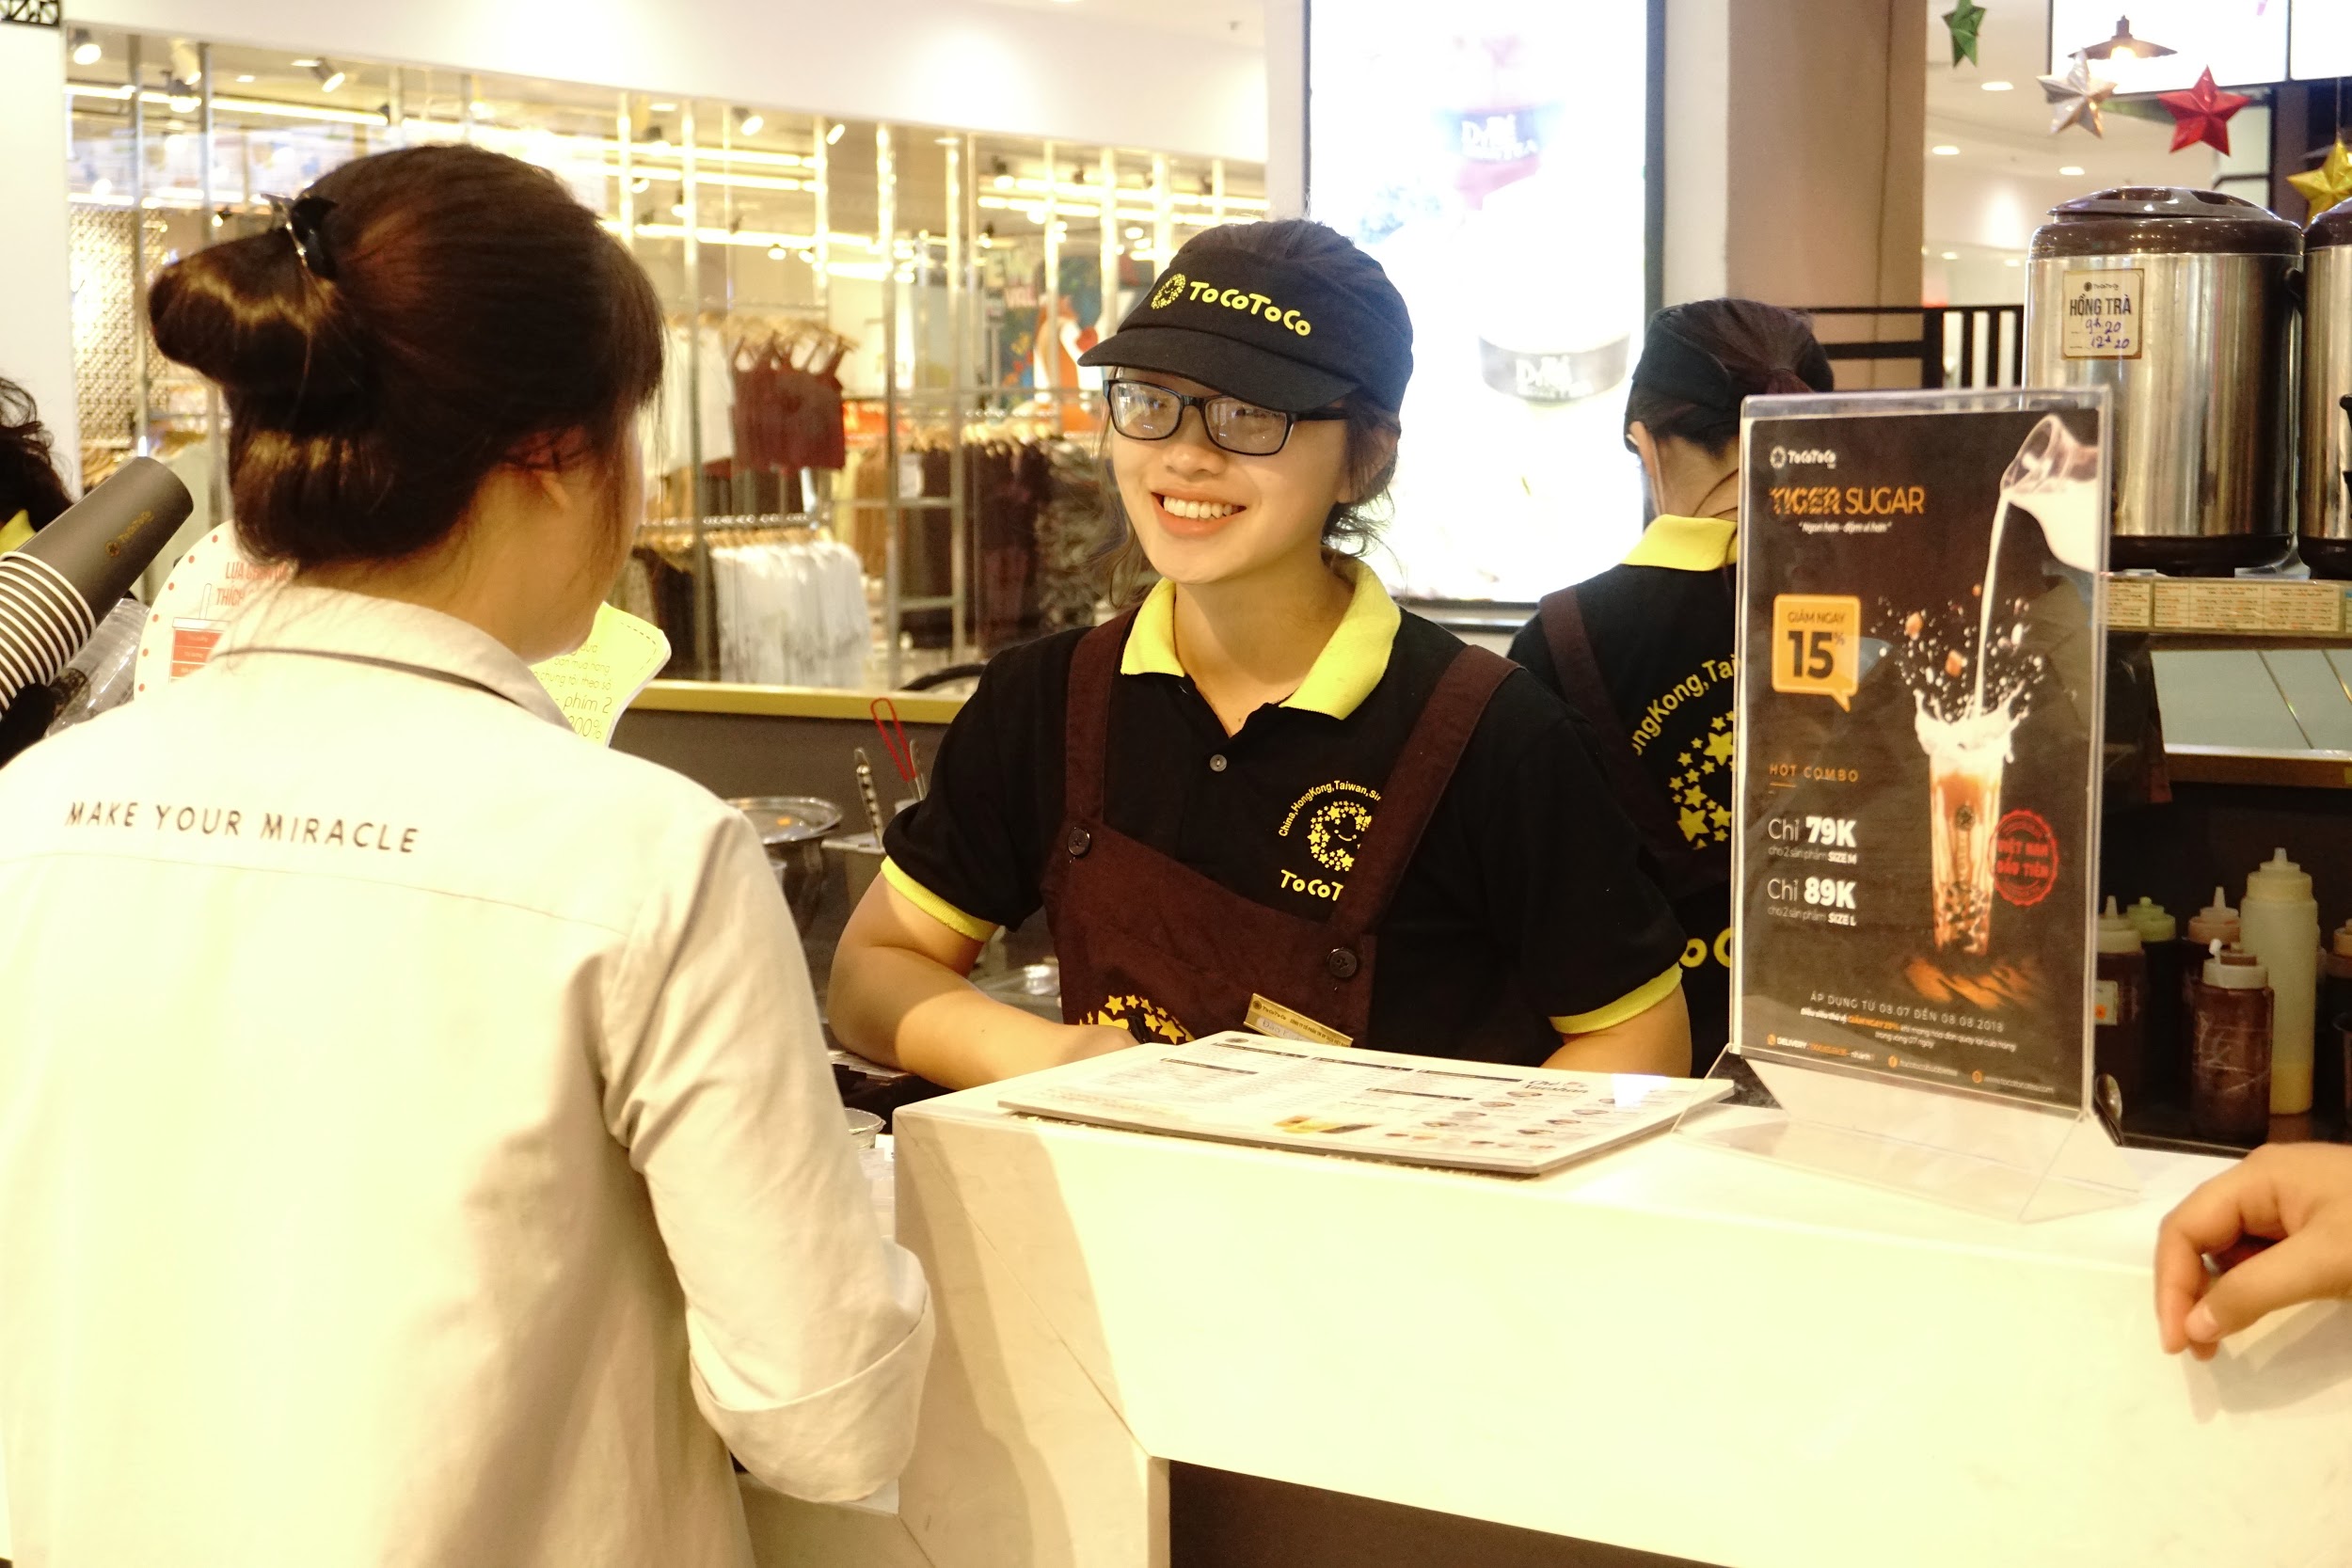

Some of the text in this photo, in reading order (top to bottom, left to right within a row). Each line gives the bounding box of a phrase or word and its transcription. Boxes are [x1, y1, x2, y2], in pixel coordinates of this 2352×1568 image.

[2070, 293, 2132, 316] HỒNG TRÀ
[1769, 485, 1925, 515] TIGER SUGAR
[563, 691, 612, 714] phím 2
[1769, 763, 1858, 783] HOT COMBO
[65, 801, 419, 853] MAKE YOUR MIRACLE
[1768, 815, 1857, 848] Chỉ 79K
[1828, 850, 1847, 863] SIZE
[1848, 852, 1857, 864] M
[1767, 876, 1857, 910] Chỉ 89K
[1828, 911, 1850, 926] SIZE
[1850, 914, 1857, 927] L
